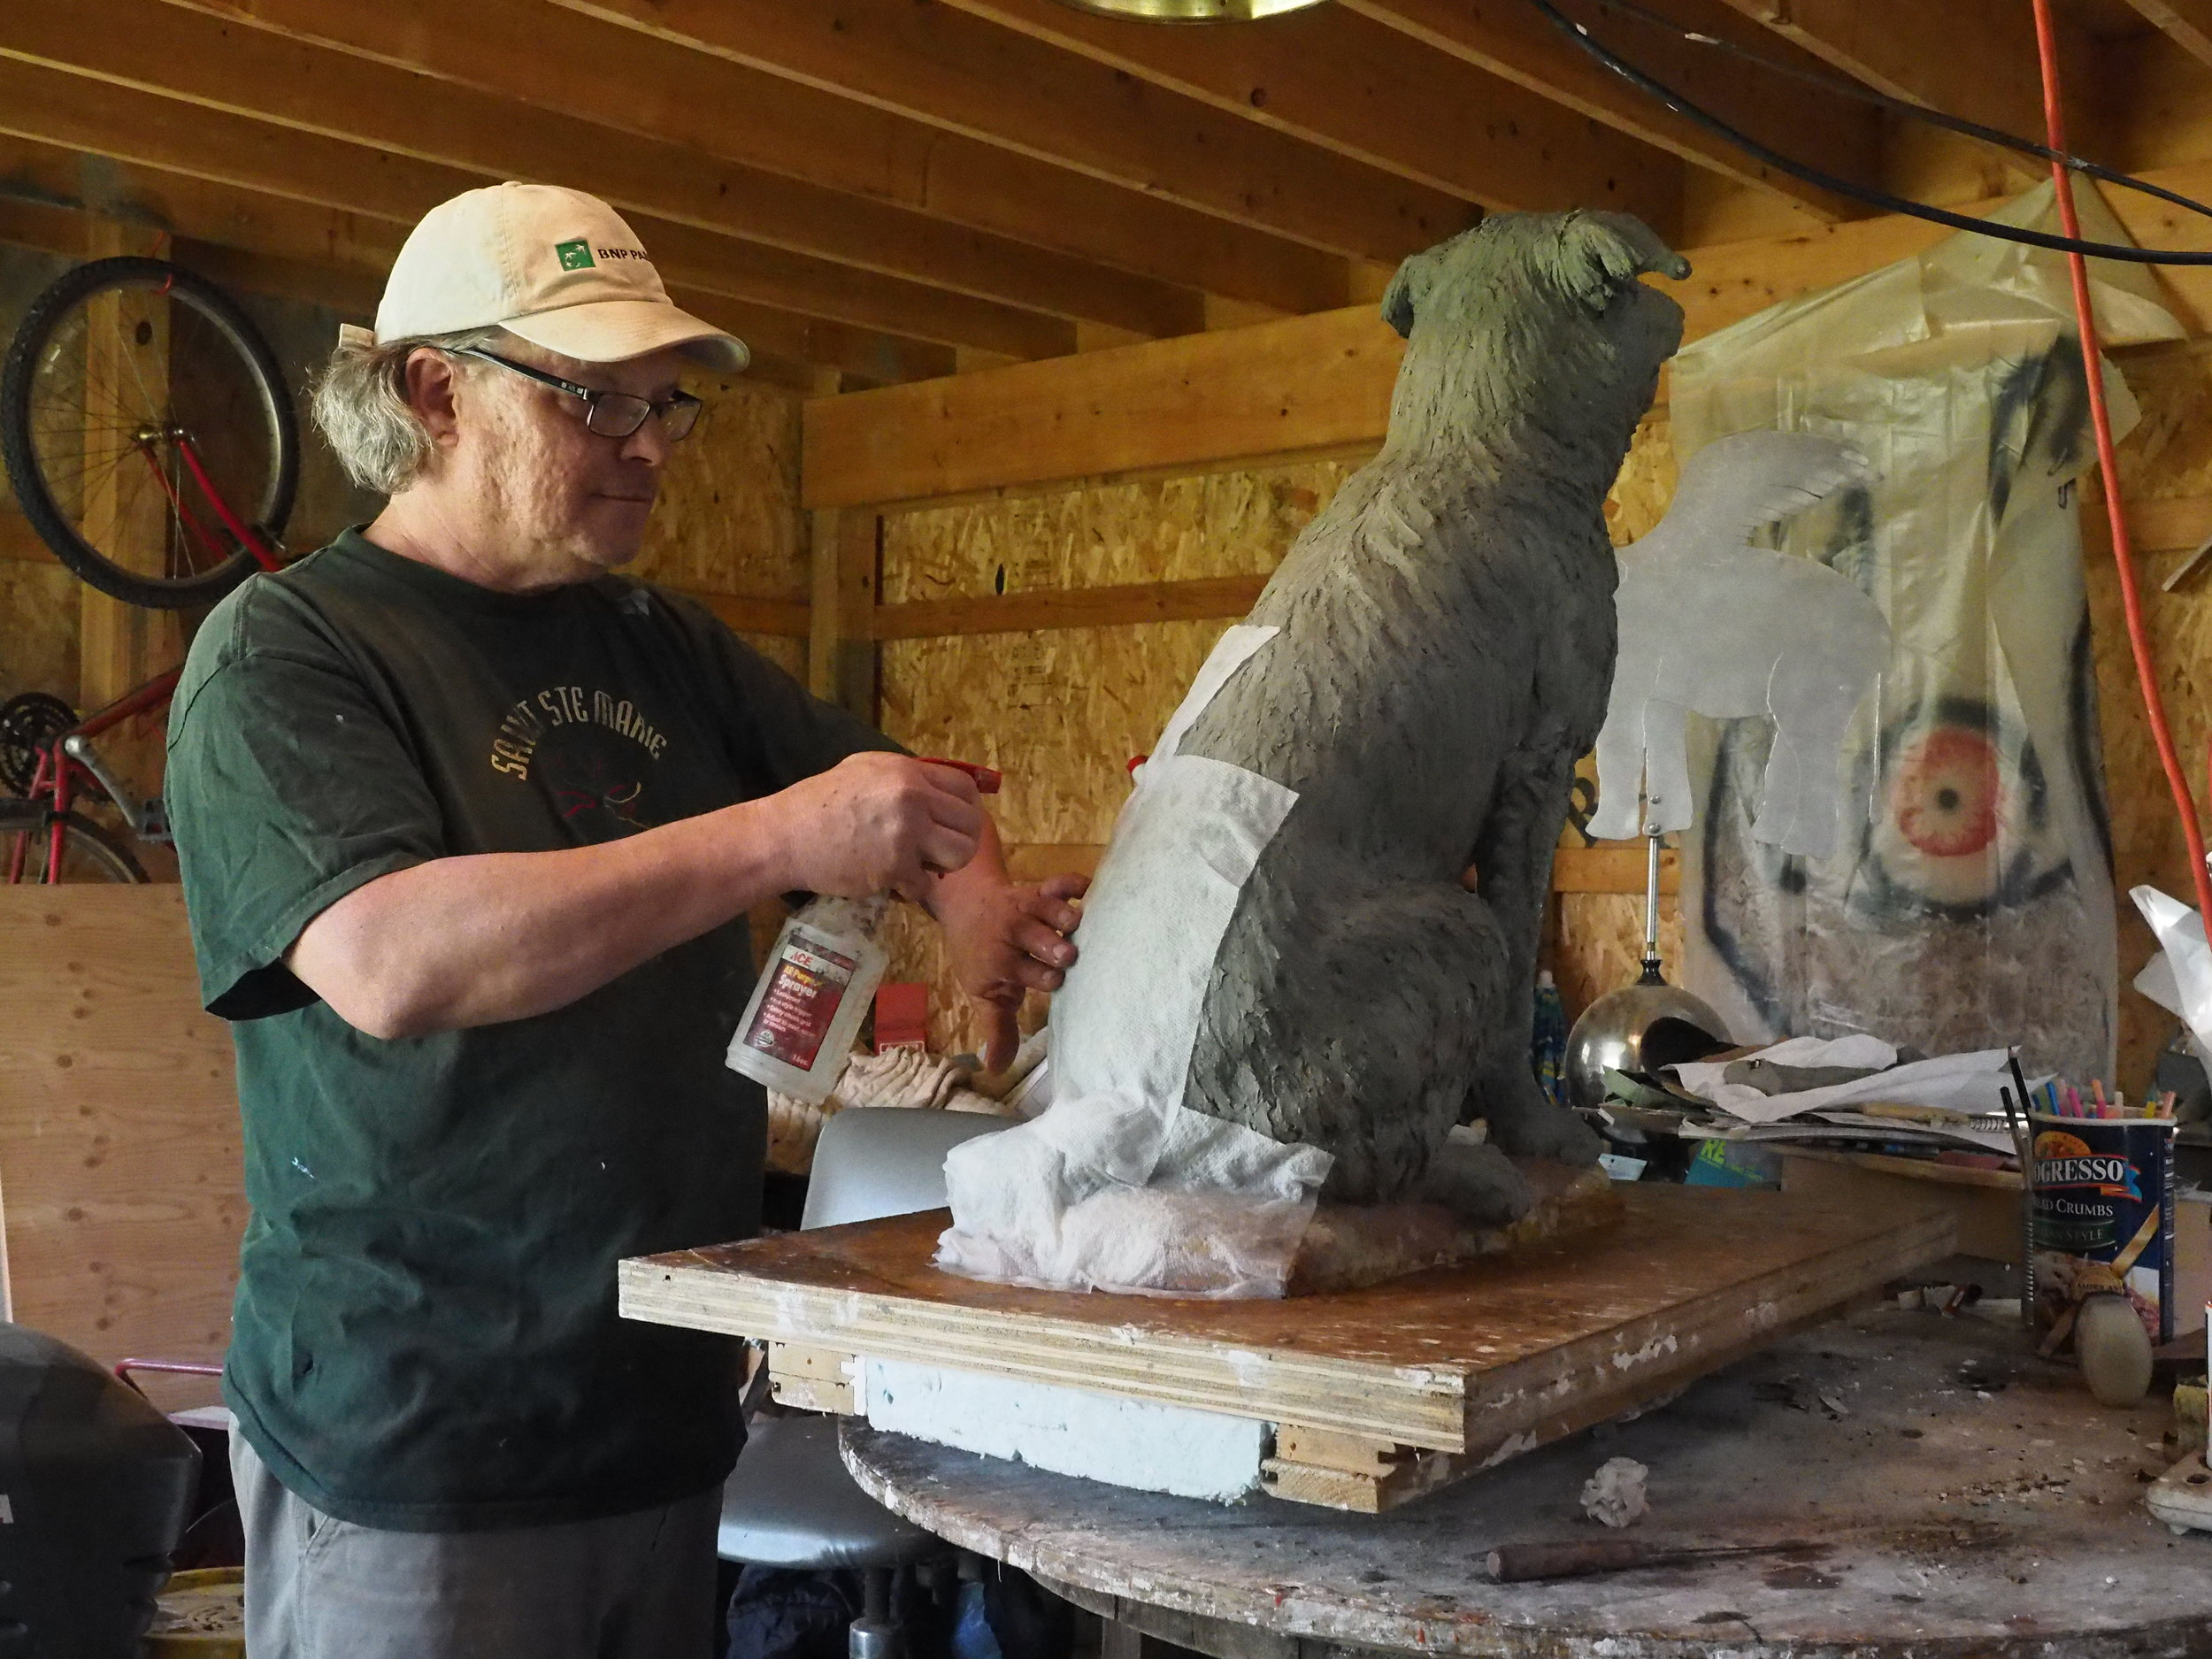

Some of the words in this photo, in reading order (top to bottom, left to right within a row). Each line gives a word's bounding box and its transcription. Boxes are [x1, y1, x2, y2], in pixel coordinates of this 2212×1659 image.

[597, 249, 627, 259] BNP
[537, 687, 588, 726] STE
[594, 690, 667, 760] MARIE
[790, 951, 813, 966] ACE
[779, 974, 818, 998] Sprayer
[793, 971, 824, 988] Purpoe
